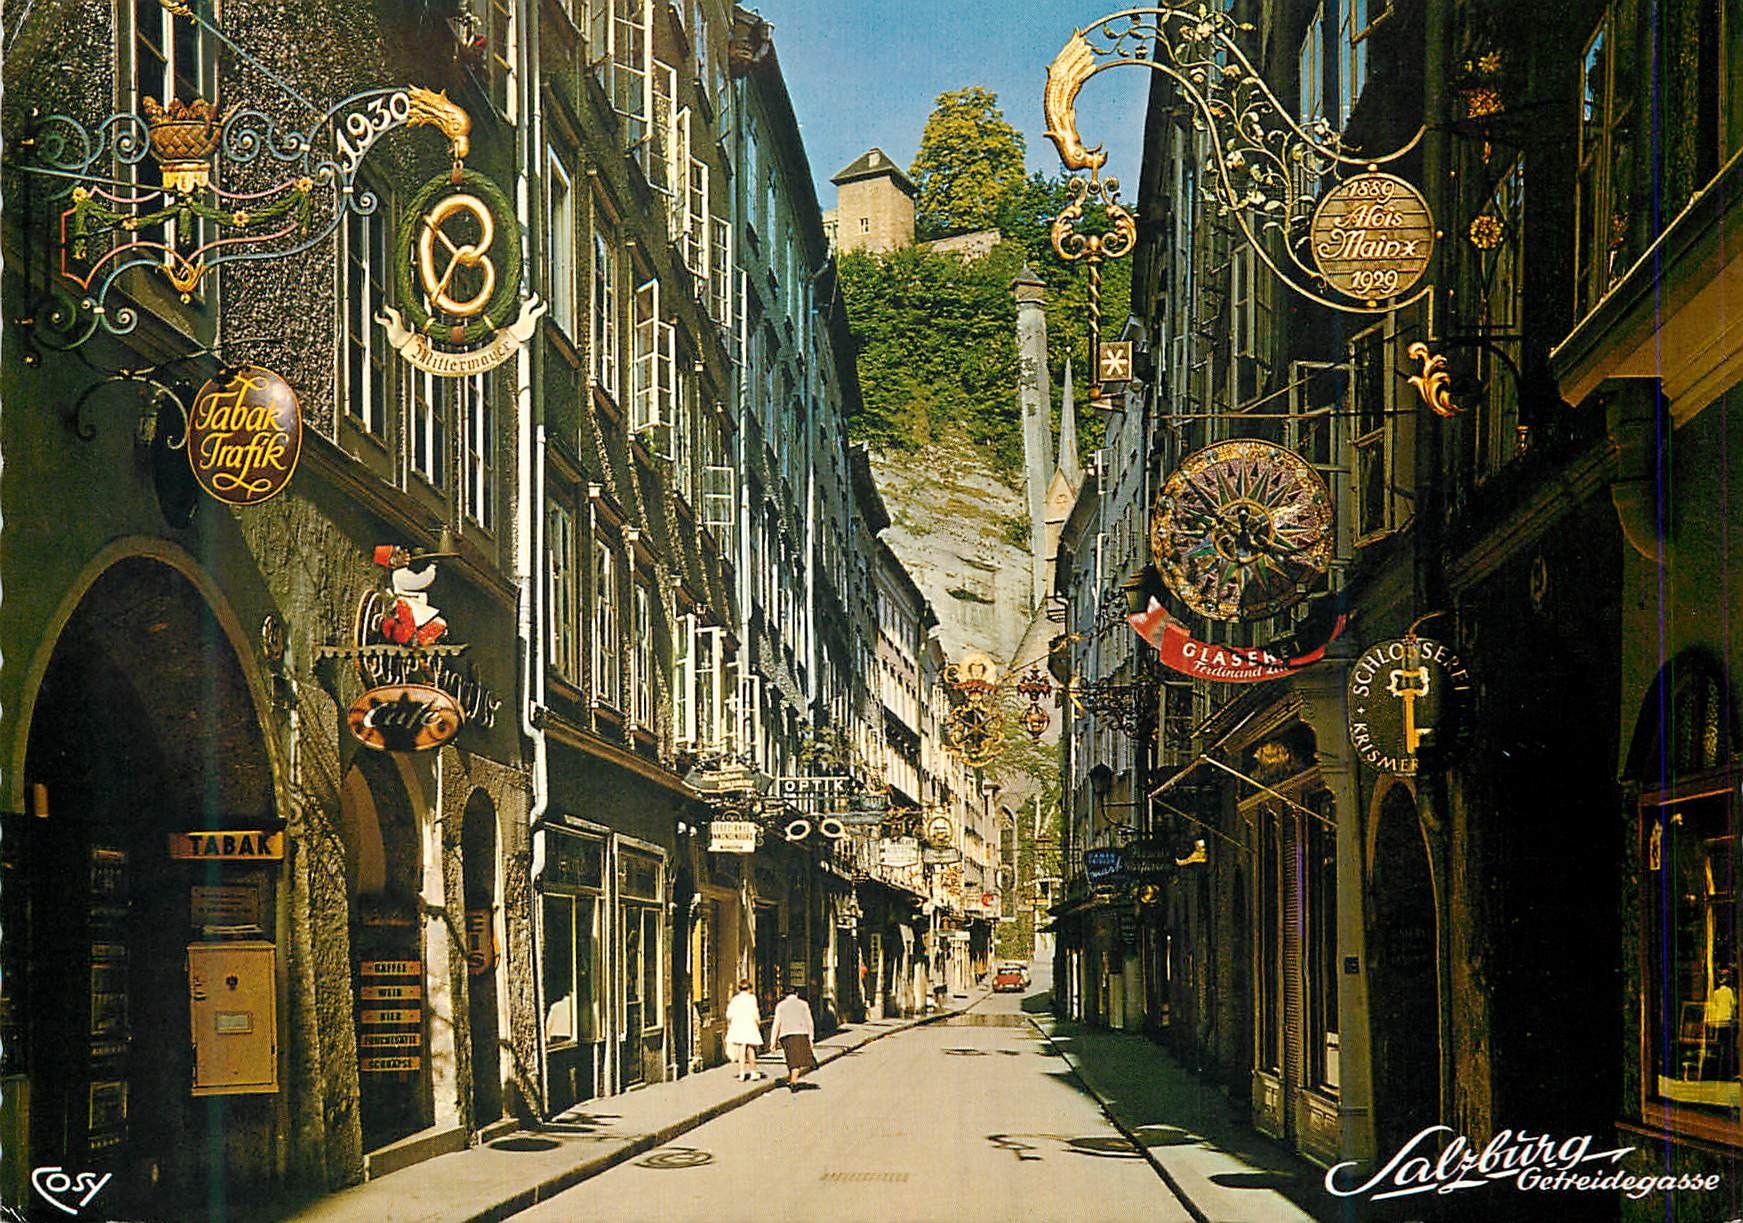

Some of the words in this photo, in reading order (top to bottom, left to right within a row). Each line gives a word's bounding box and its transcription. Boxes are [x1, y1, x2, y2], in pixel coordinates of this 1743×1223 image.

[336, 91, 411, 173] 1930
[1348, 180, 1395, 203] 1889
[1334, 204, 1404, 228] Alois
[1318, 228, 1420, 259] Mainx
[1352, 270, 1399, 294] 1929
[410, 335, 512, 373] Mittermayer
[195, 373, 287, 432] Tabak
[199, 432, 290, 499] Trafik
[1193, 659, 1263, 679] Ferdinand
[1353, 721, 1420, 772] KRISMER
[784, 780, 844, 794] OPTIK
[188, 834, 272, 856] TABAK
